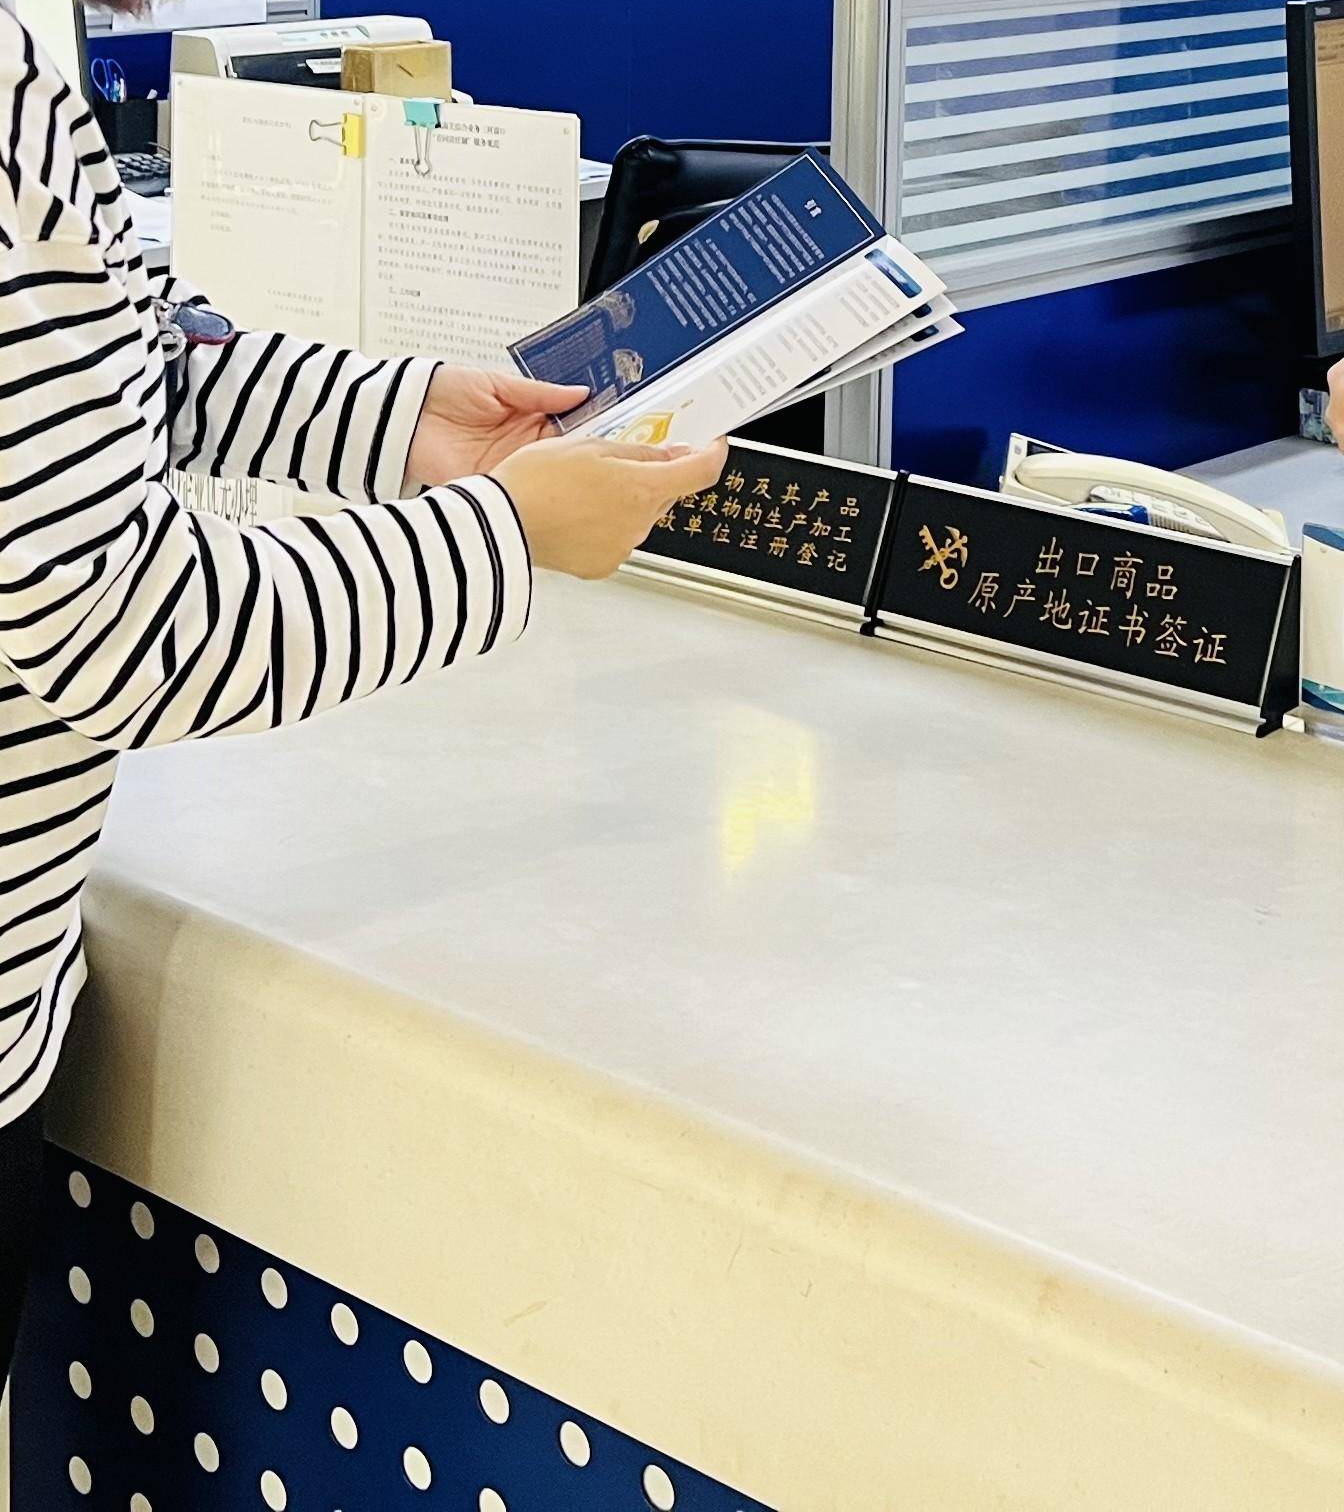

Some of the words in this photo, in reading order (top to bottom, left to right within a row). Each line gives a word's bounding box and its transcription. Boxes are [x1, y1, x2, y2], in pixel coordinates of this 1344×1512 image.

[724, 469, 860, 517] 物及其产品
[1035, 536, 1179, 600] 出口商品
[967, 571, 1228, 666] 原产地证书签证
